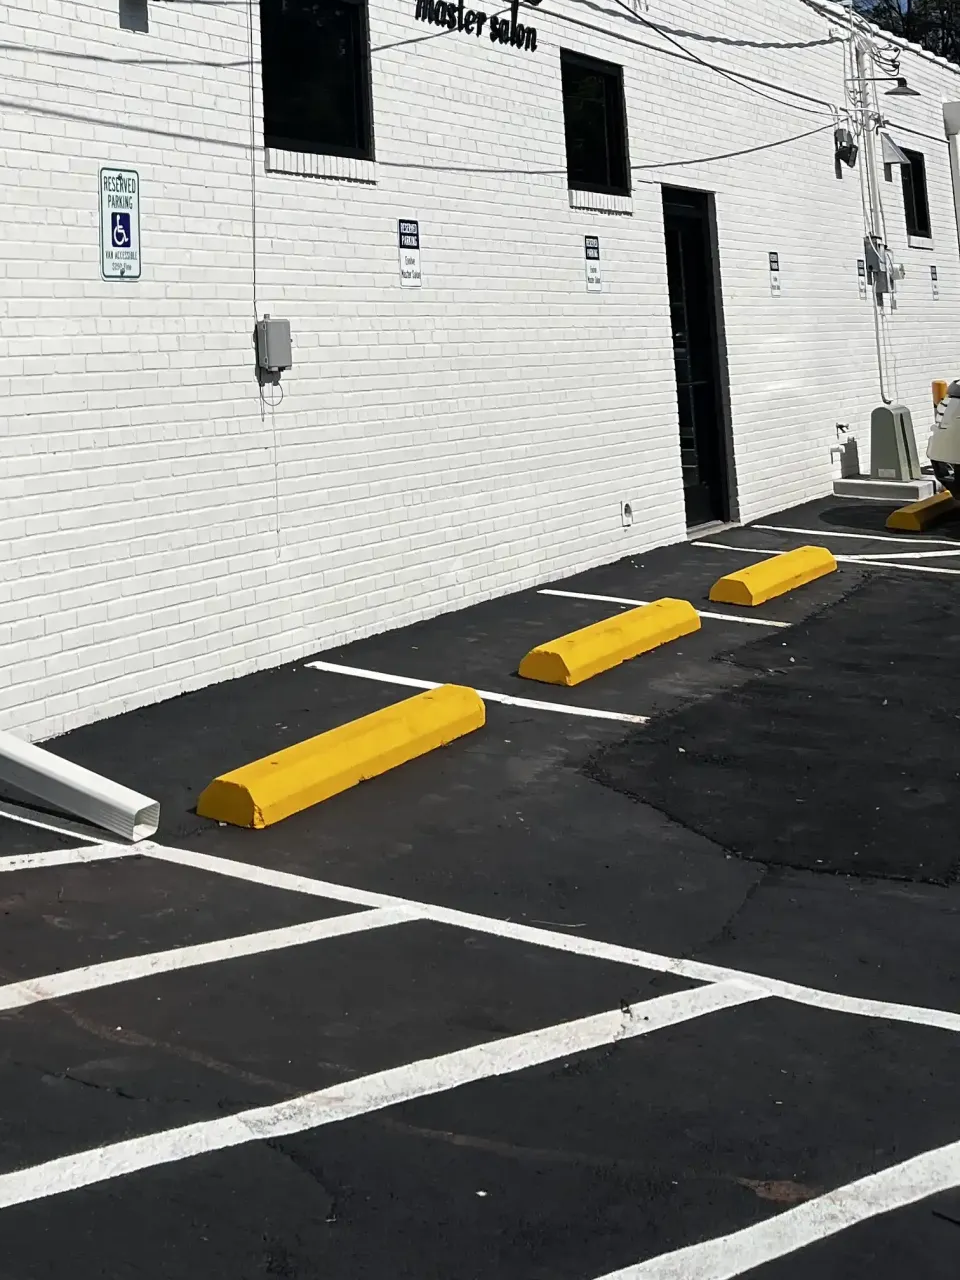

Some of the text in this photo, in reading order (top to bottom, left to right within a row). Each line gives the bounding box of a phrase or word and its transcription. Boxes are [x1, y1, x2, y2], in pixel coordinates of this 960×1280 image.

[103, 176, 136, 193] RESERVED
[107, 194, 133, 209] PARKING
[400, 223, 417, 234] RESERVED
[401, 235, 418, 246] PARKING
[105, 251, 137, 260] VAN ACCESSIBLE
